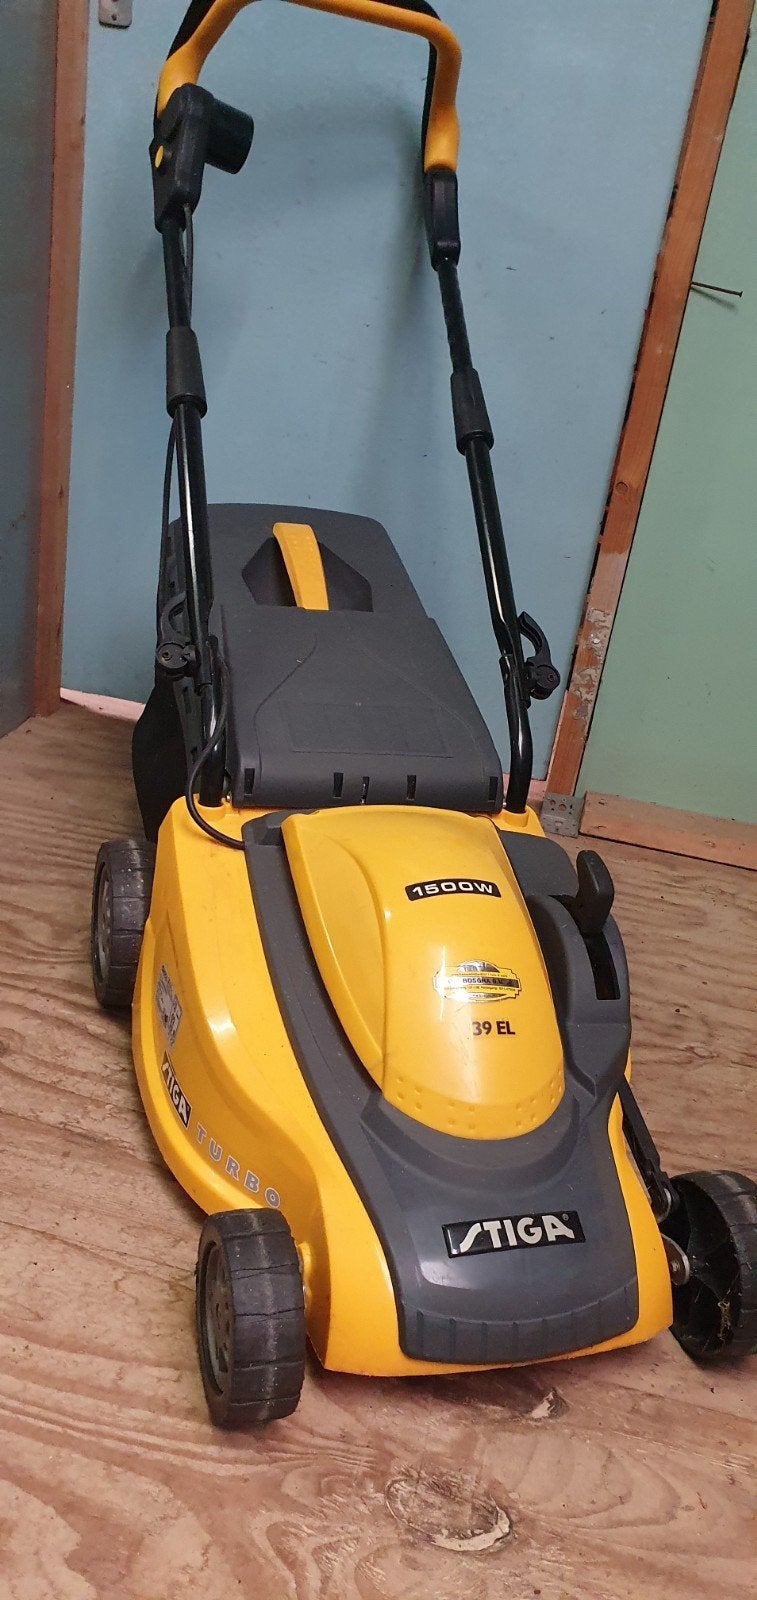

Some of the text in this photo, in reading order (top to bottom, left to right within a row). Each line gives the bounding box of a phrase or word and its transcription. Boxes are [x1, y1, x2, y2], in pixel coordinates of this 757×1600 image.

[412, 881, 494, 897] 1500W
[472, 1021, 516, 1036] 39 EL
[161, 1062, 188, 1125] STIGA
[197, 1122, 281, 1209] TURBO
[459, 1214, 575, 1253] STIGA
